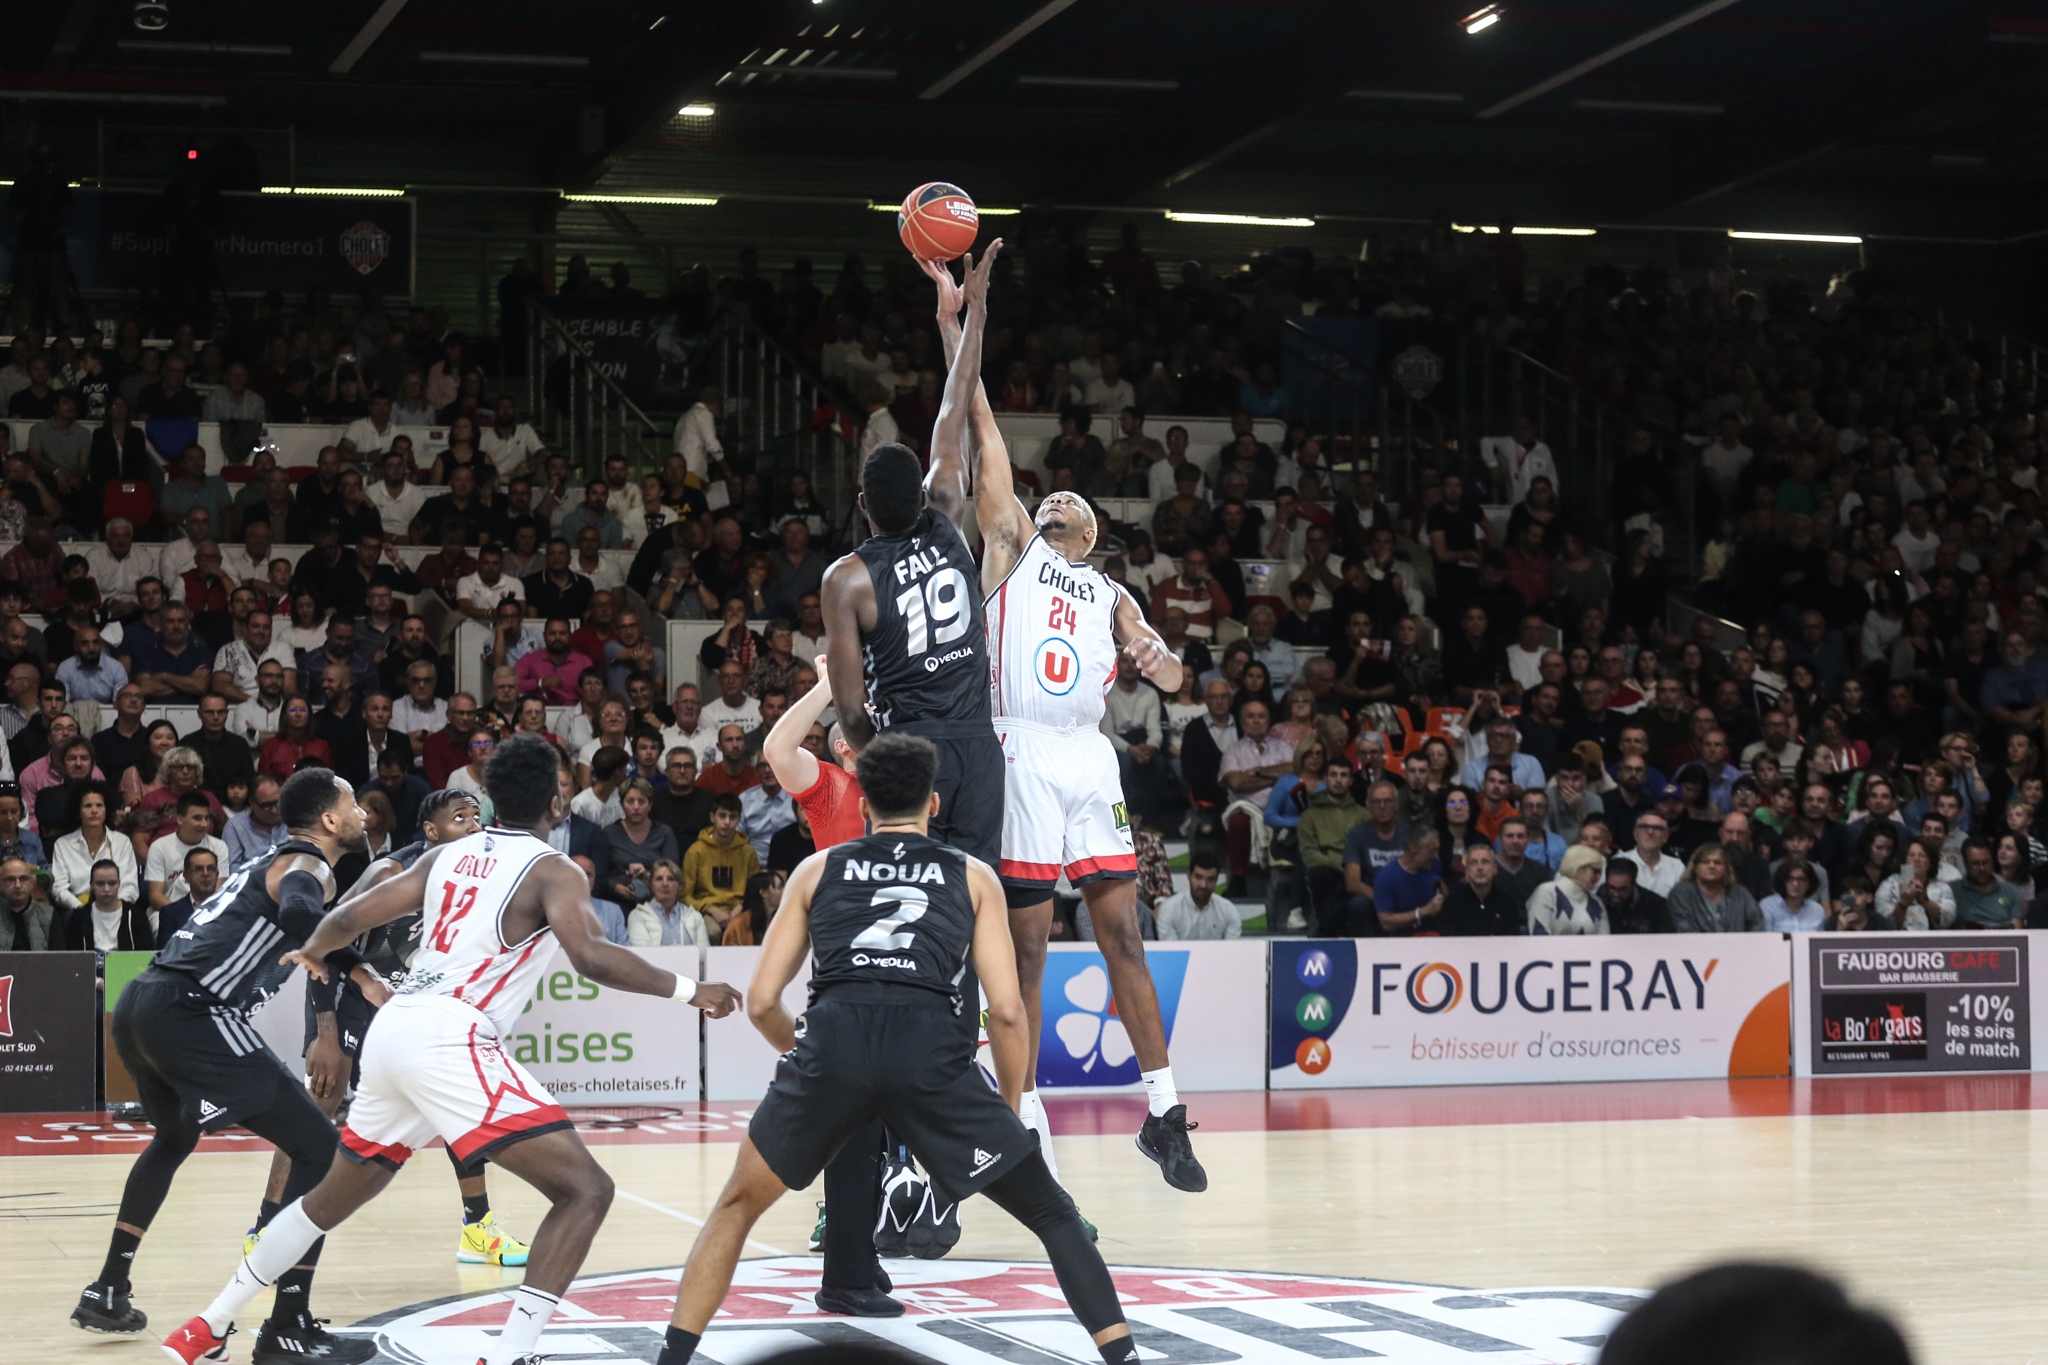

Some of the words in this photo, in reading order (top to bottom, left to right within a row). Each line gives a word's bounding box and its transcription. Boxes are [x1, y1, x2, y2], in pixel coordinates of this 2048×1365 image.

[894, 546, 948, 585] FALL
[1038, 562, 1095, 603] CHOLET
[896, 568, 971, 657] 19
[1049, 597, 1077, 636] 24
[939, 647, 973, 664] VEOLIA
[1045, 651, 1070, 683] U
[844, 859, 945, 885] NOUA
[426, 880, 479, 954] 12
[850, 886, 929, 951] 2
[871, 957, 916, 971] VEOLIA
[1838, 952, 1944, 970] FAUBOURG
[1950, 951, 2000, 968] CAFE
[1372, 958, 1719, 1015] FOUGERAY
[1879, 973, 1899, 984] BAR
[1902, 972, 1959, 983] BRASSERIE
[1949, 994, 2014, 1022] -10%
[1946, 1021, 1969, 1038] les
[1975, 1023, 2015, 1039] soirs
[1411, 1032, 1519, 1060] bâtisseur
[1527, 1030, 1681, 1058] d'assurances
[1827, 1052, 1867, 1060] RESTAURANT
[1870, 1052, 1890, 1060] TAPAS
[1945, 1040, 1967, 1055] de
[1970, 1041, 2019, 1058] match
[5, 1064, 14, 1072] 02
[15, 1064, 23, 1072] 41
[25, 1064, 33, 1072] 62
[35, 1064, 43, 1072] 45
[45, 1064, 53, 1072] 45
